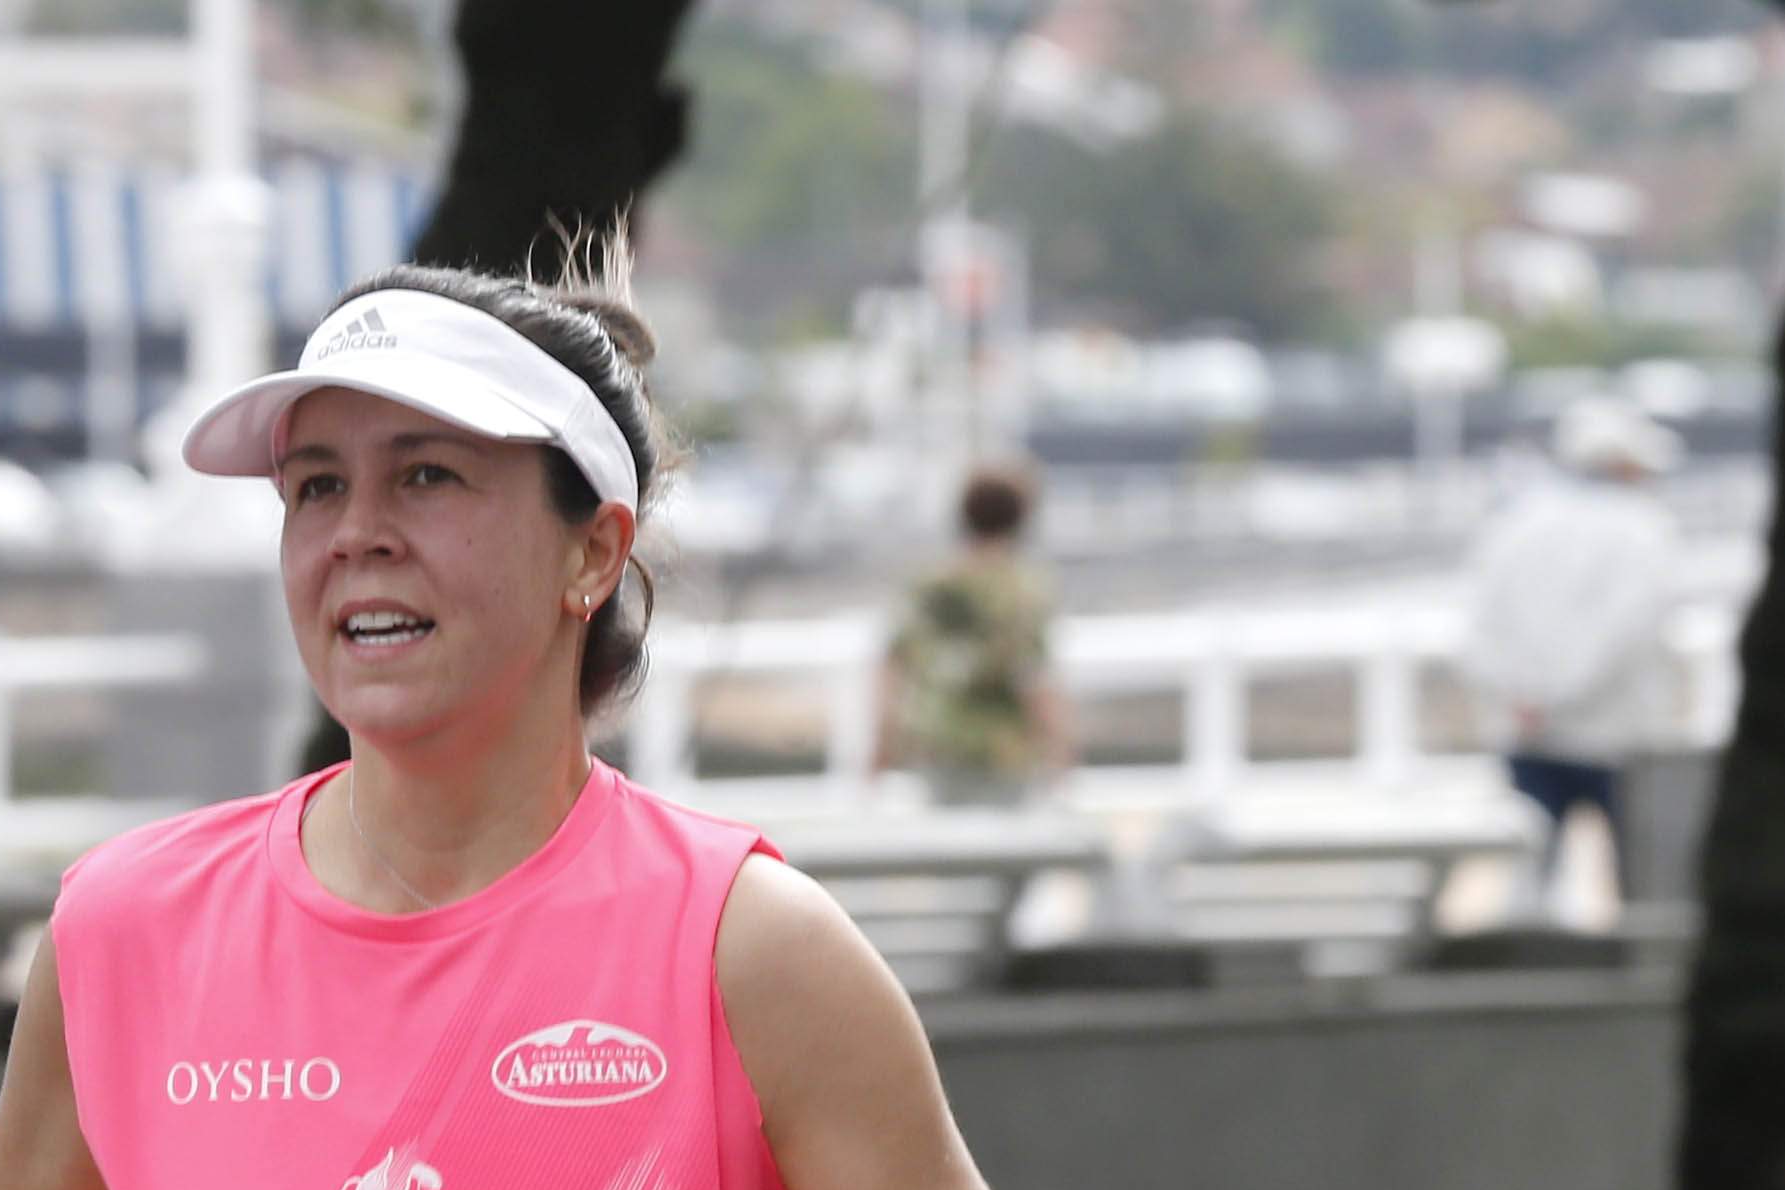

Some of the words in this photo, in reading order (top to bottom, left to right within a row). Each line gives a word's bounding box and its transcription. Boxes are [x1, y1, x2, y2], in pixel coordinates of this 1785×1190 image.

[317, 330, 398, 361] adidas
[166, 1056, 341, 1106] OYSHO
[505, 1053, 654, 1088] ASTURIANA
